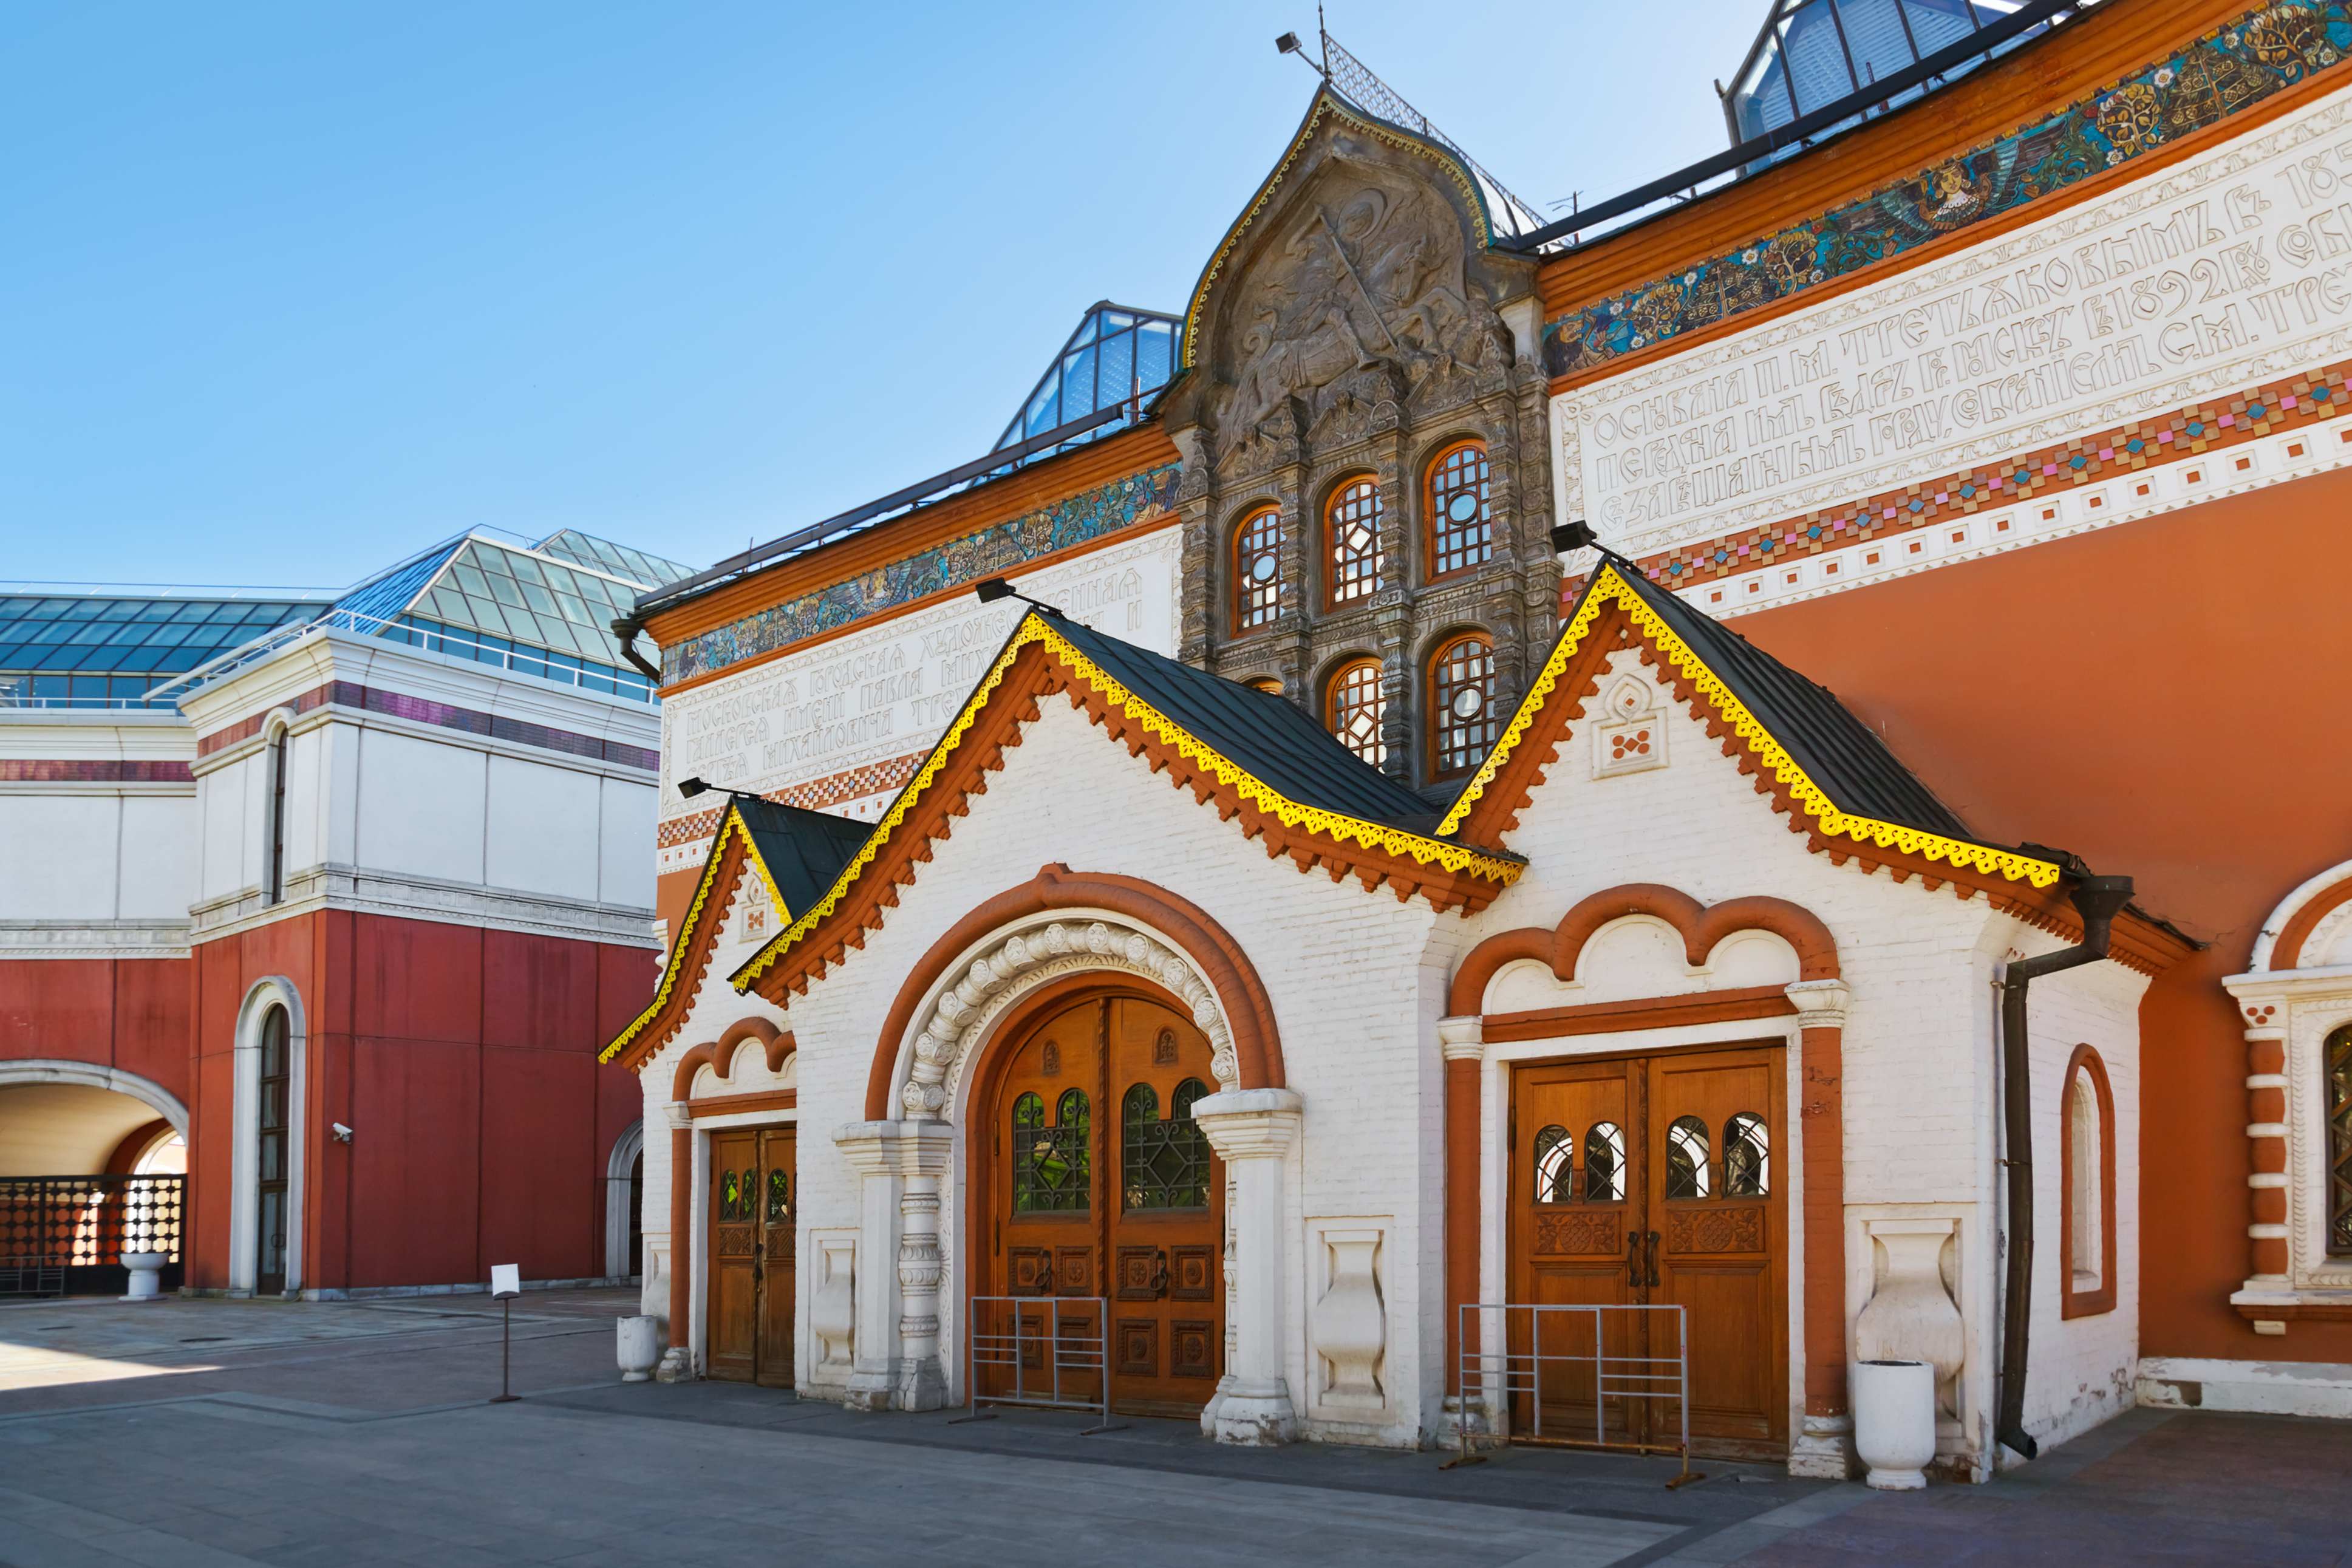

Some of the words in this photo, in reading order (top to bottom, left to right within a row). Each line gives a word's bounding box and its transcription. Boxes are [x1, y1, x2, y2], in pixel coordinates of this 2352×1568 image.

[1597, 416, 1737, 493] ПЕРЕДАНА
[686, 717, 770, 764] ГАЛЛЕРЕЯ
[783, 692, 845, 734] ИМЕНИ
[861, 667, 923, 712] ПАВЛА
[687, 677, 799, 735] МОСКОВСКАЯ
[810, 643, 905, 697] ГОРОДСКАЯ
